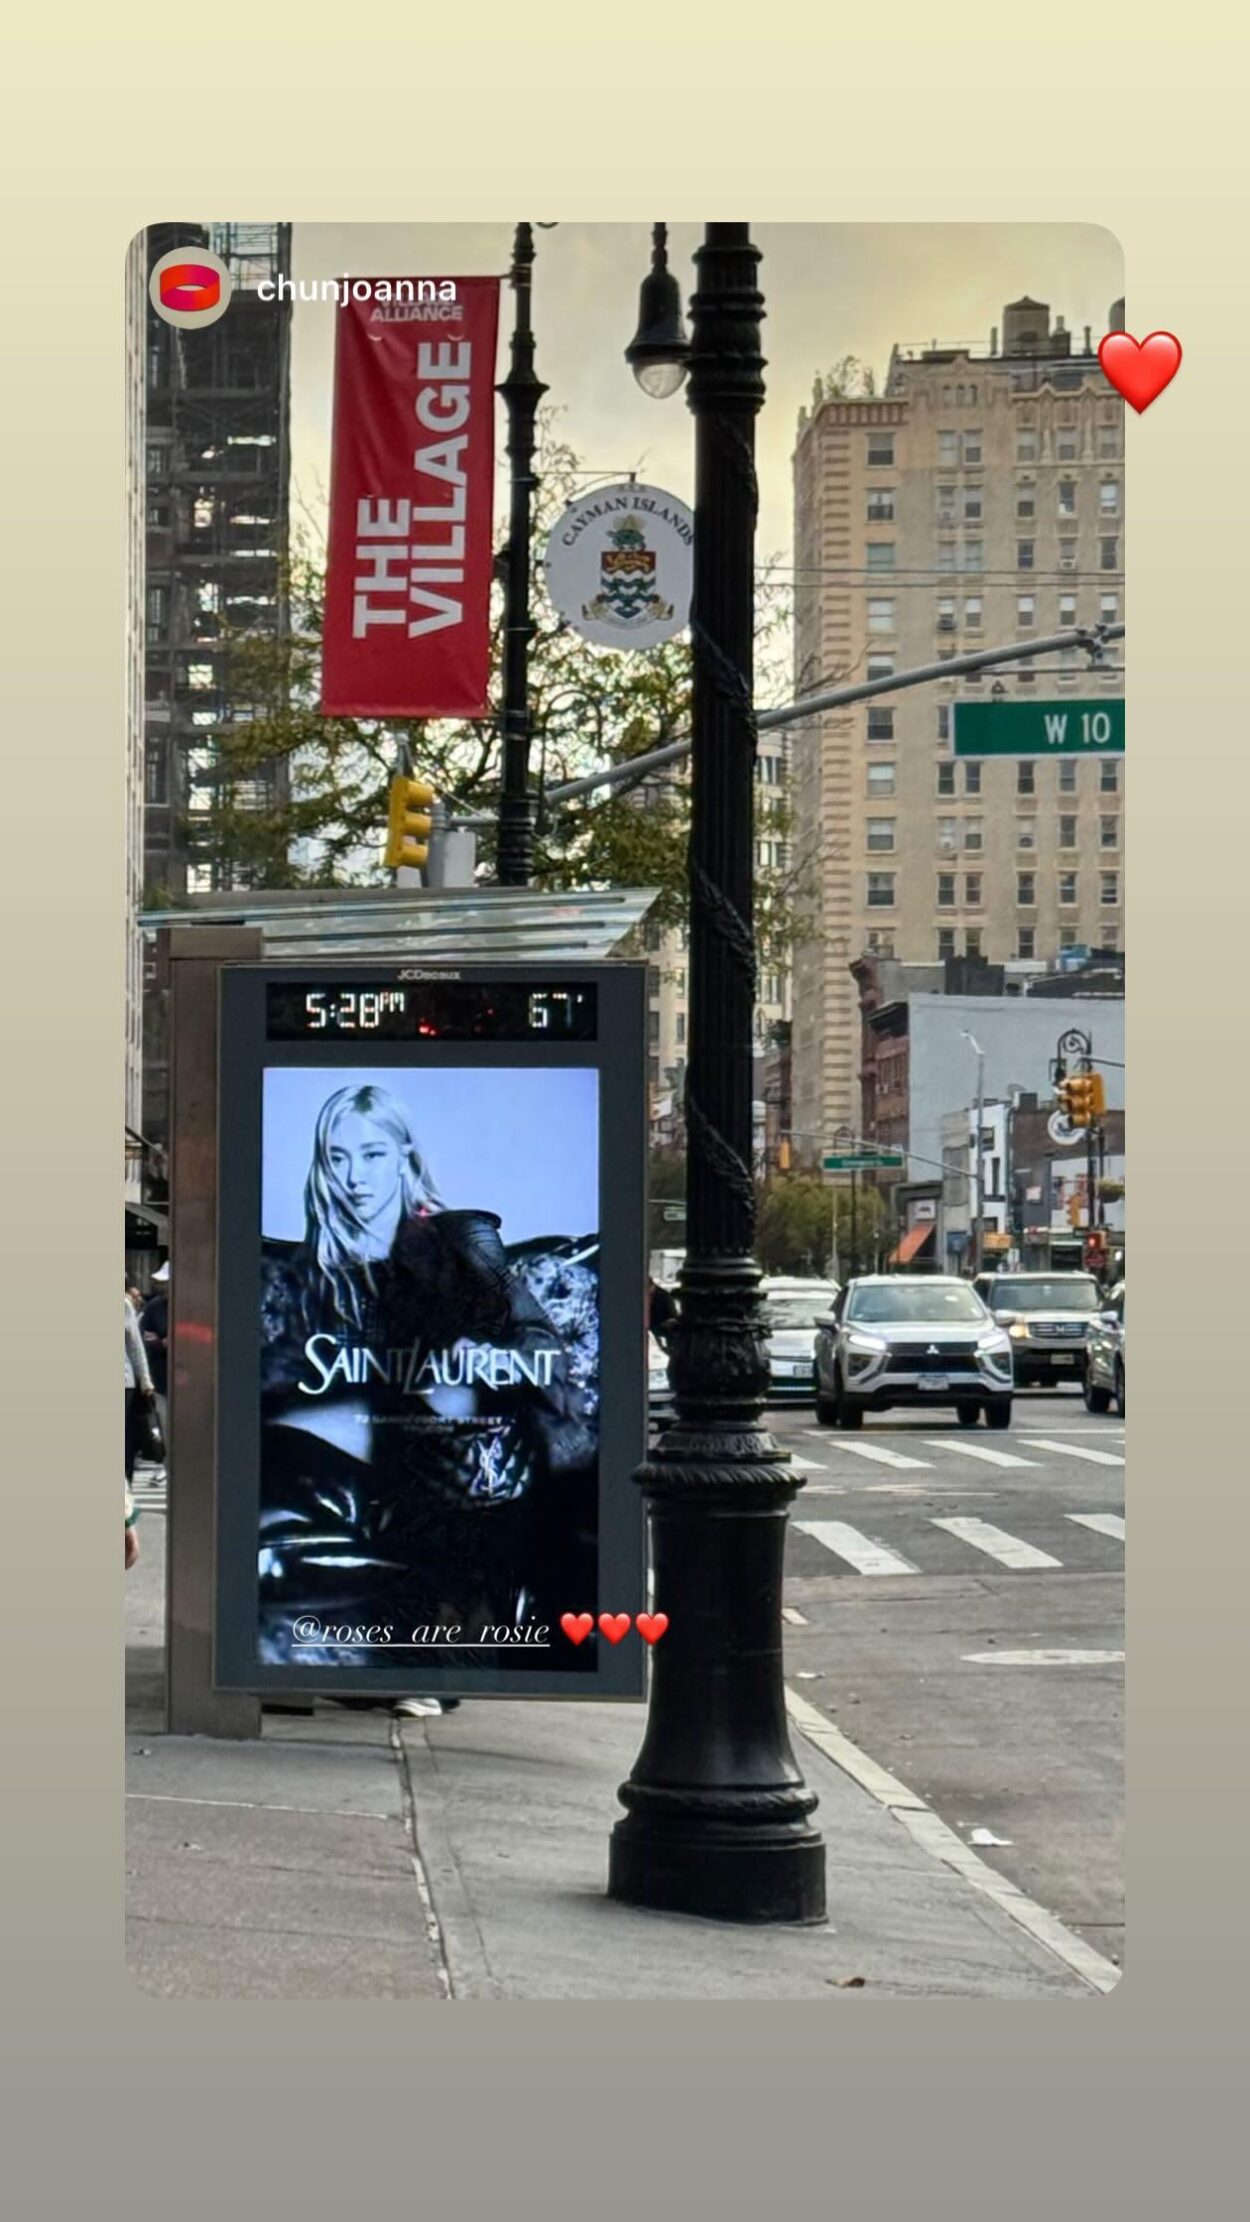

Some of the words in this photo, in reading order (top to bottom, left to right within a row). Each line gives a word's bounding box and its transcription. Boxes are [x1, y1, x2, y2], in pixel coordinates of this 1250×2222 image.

[370, 305, 463, 322] ALLIANCE
[408, 340, 472, 638] VILLAGE
[562, 497, 628, 547] CAYMAN
[633, 496, 694, 547] ISLANDS
[352, 495, 411, 639] THE
[1044, 714, 1069, 745] W
[1082, 712, 1111, 743] 10
[397, 969, 461, 982] JCDecaux
